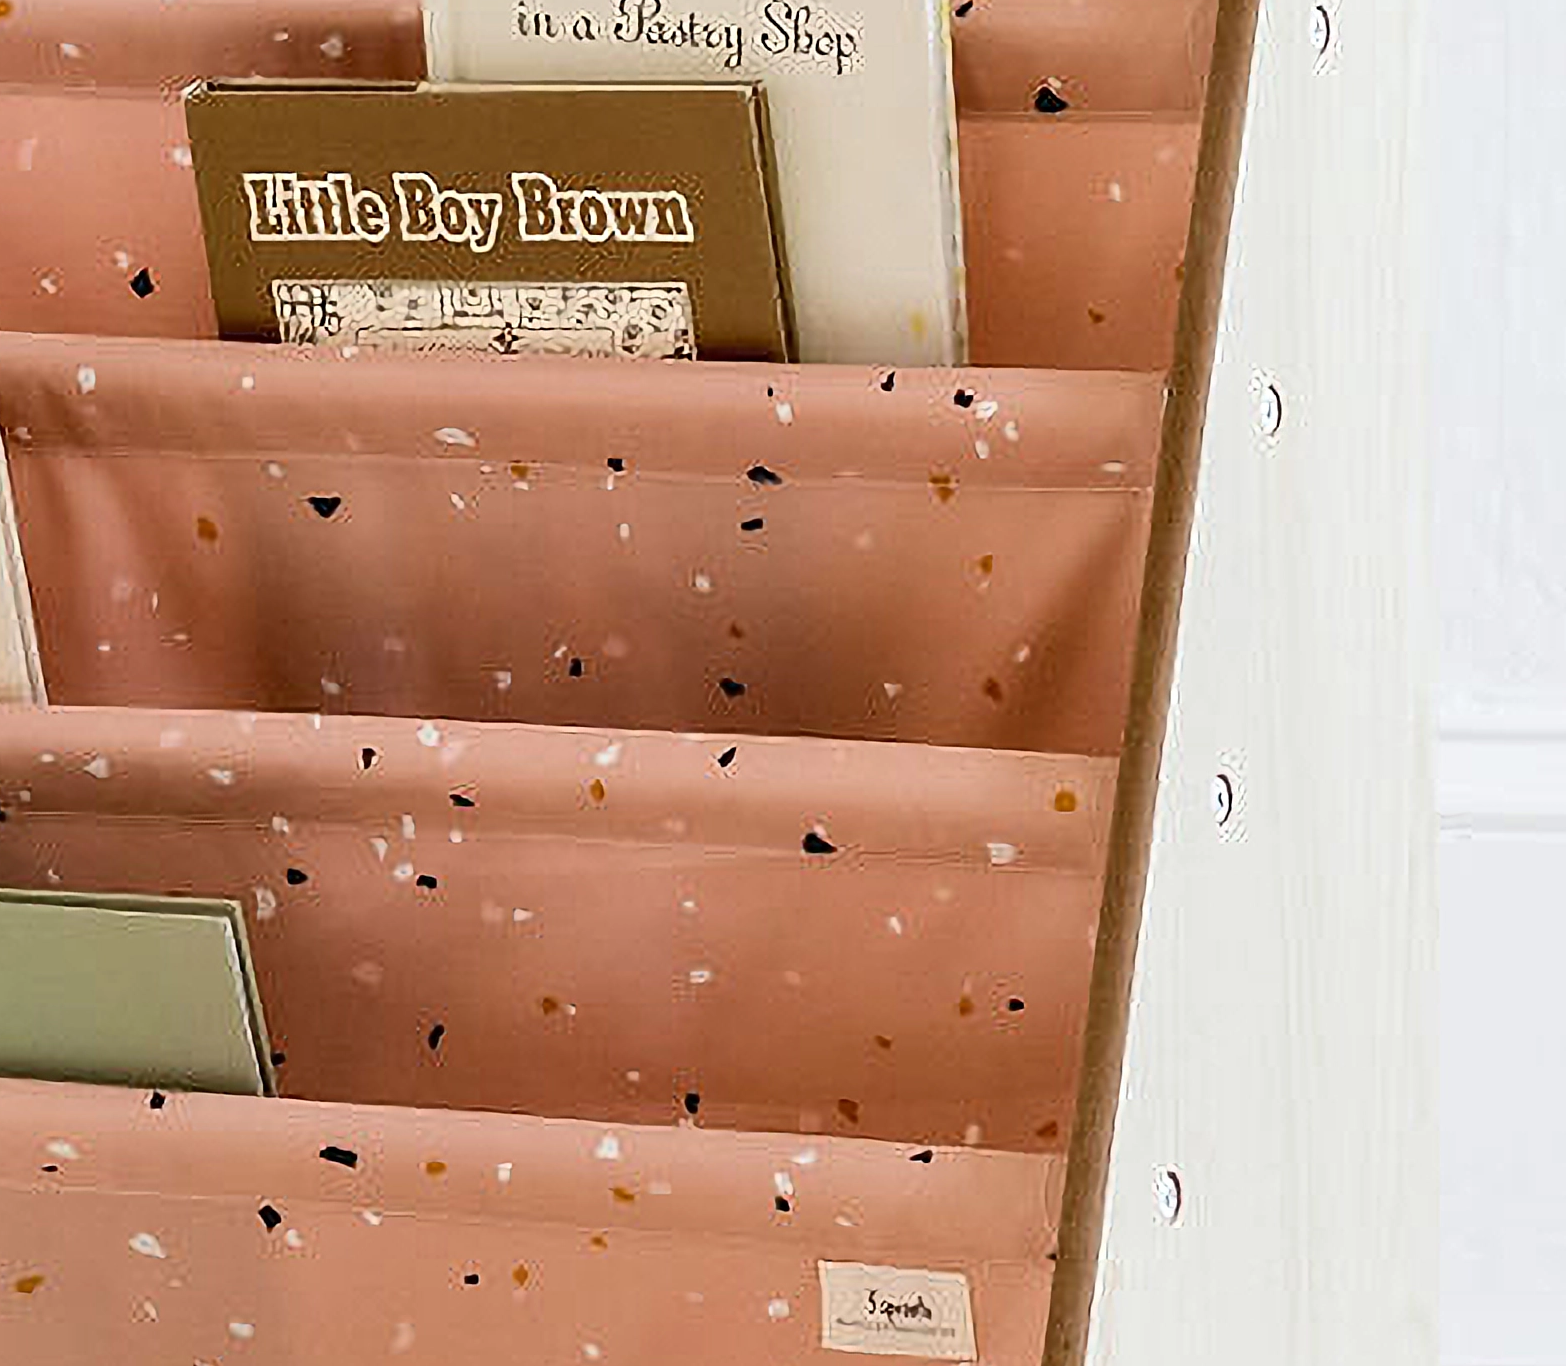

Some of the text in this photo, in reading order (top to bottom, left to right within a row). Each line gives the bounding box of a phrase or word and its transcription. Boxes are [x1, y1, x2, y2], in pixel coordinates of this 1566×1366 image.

[517, 0, 553, 37] in
[572, 13, 595, 41] a
[760, 0, 860, 75] Shop
[243, 172, 695, 253] Little Boy Brown
